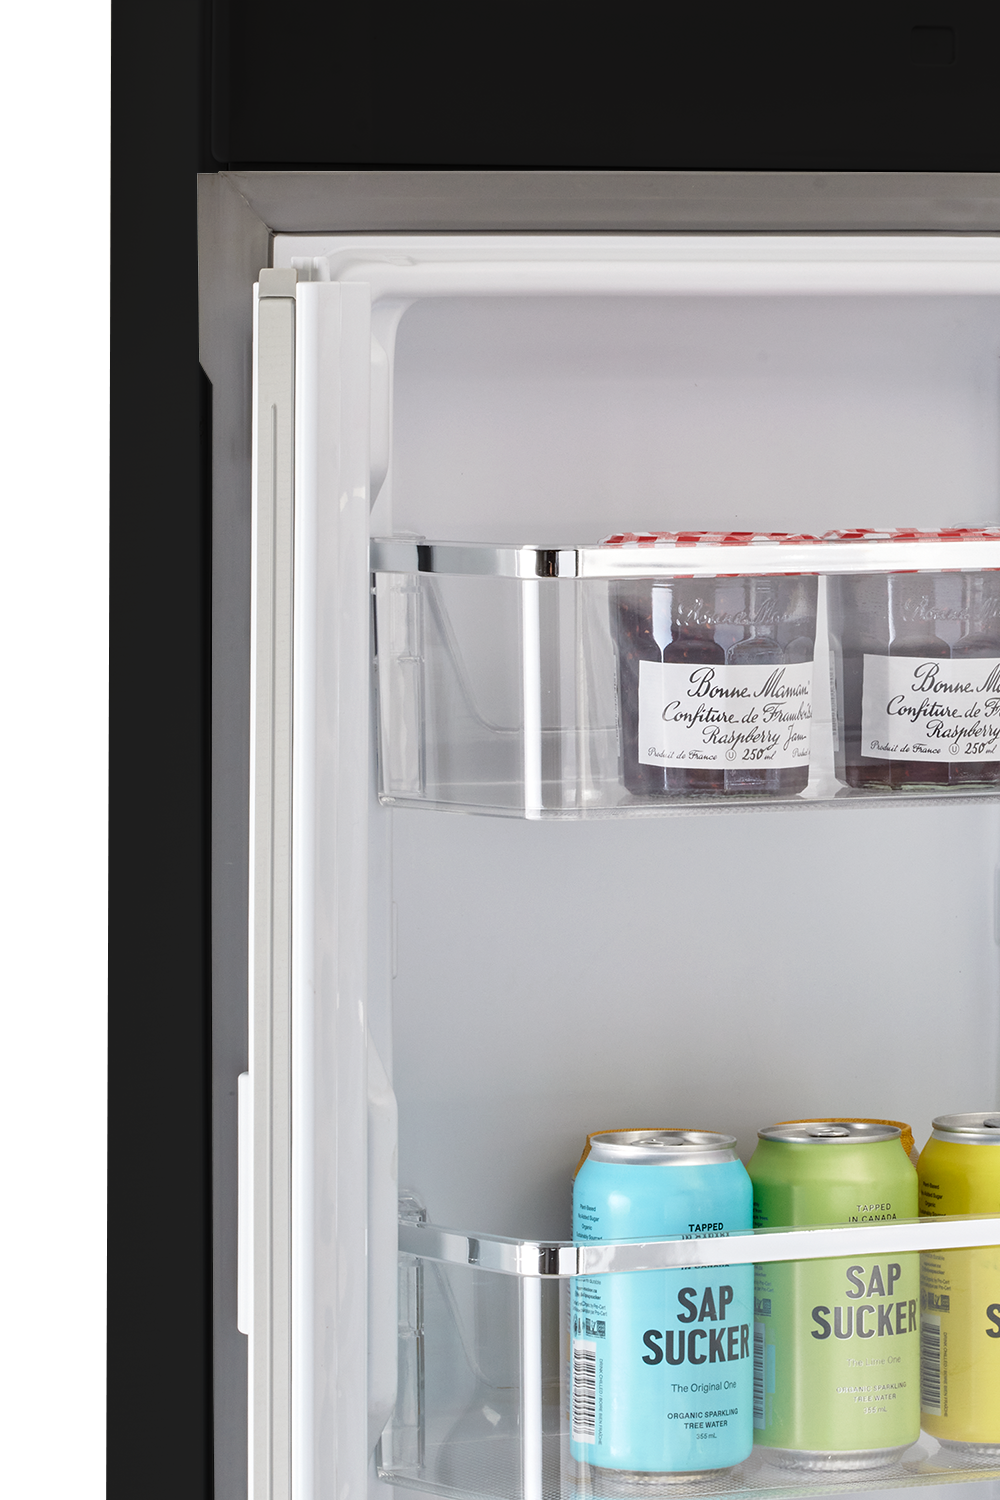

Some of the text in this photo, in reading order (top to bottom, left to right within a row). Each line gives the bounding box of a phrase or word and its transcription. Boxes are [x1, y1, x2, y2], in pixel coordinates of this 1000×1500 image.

[687, 666, 808, 698] Bonne Maman
[912, 662, 974, 693] Bonne
[662, 700, 759, 728] Confiture de
[886, 694, 980, 722] Confiture de
[702, 724, 807, 750] Raspberry Jam
[676, 750, 686, 760] de
[688, 750, 718, 760] France
[742, 748, 764, 761] 250
[856, 1203, 892, 1212] TAPPED
[861, 1213, 898, 1222] CANADA
[688, 1222, 724, 1232] TAPPED
[846, 1262, 902, 1300] SAP
[676, 1285, 734, 1324] SAP
[810, 1300, 918, 1340] SUCKER
[642, 1324, 750, 1366] SUCKER
[846, 1356, 902, 1368] The Lime One
[671, 1380, 738, 1394] The Original One
[667, 1408, 739, 1420] ORGANIC SPARKLING
[684, 1420, 728, 1430] TREE WATER
